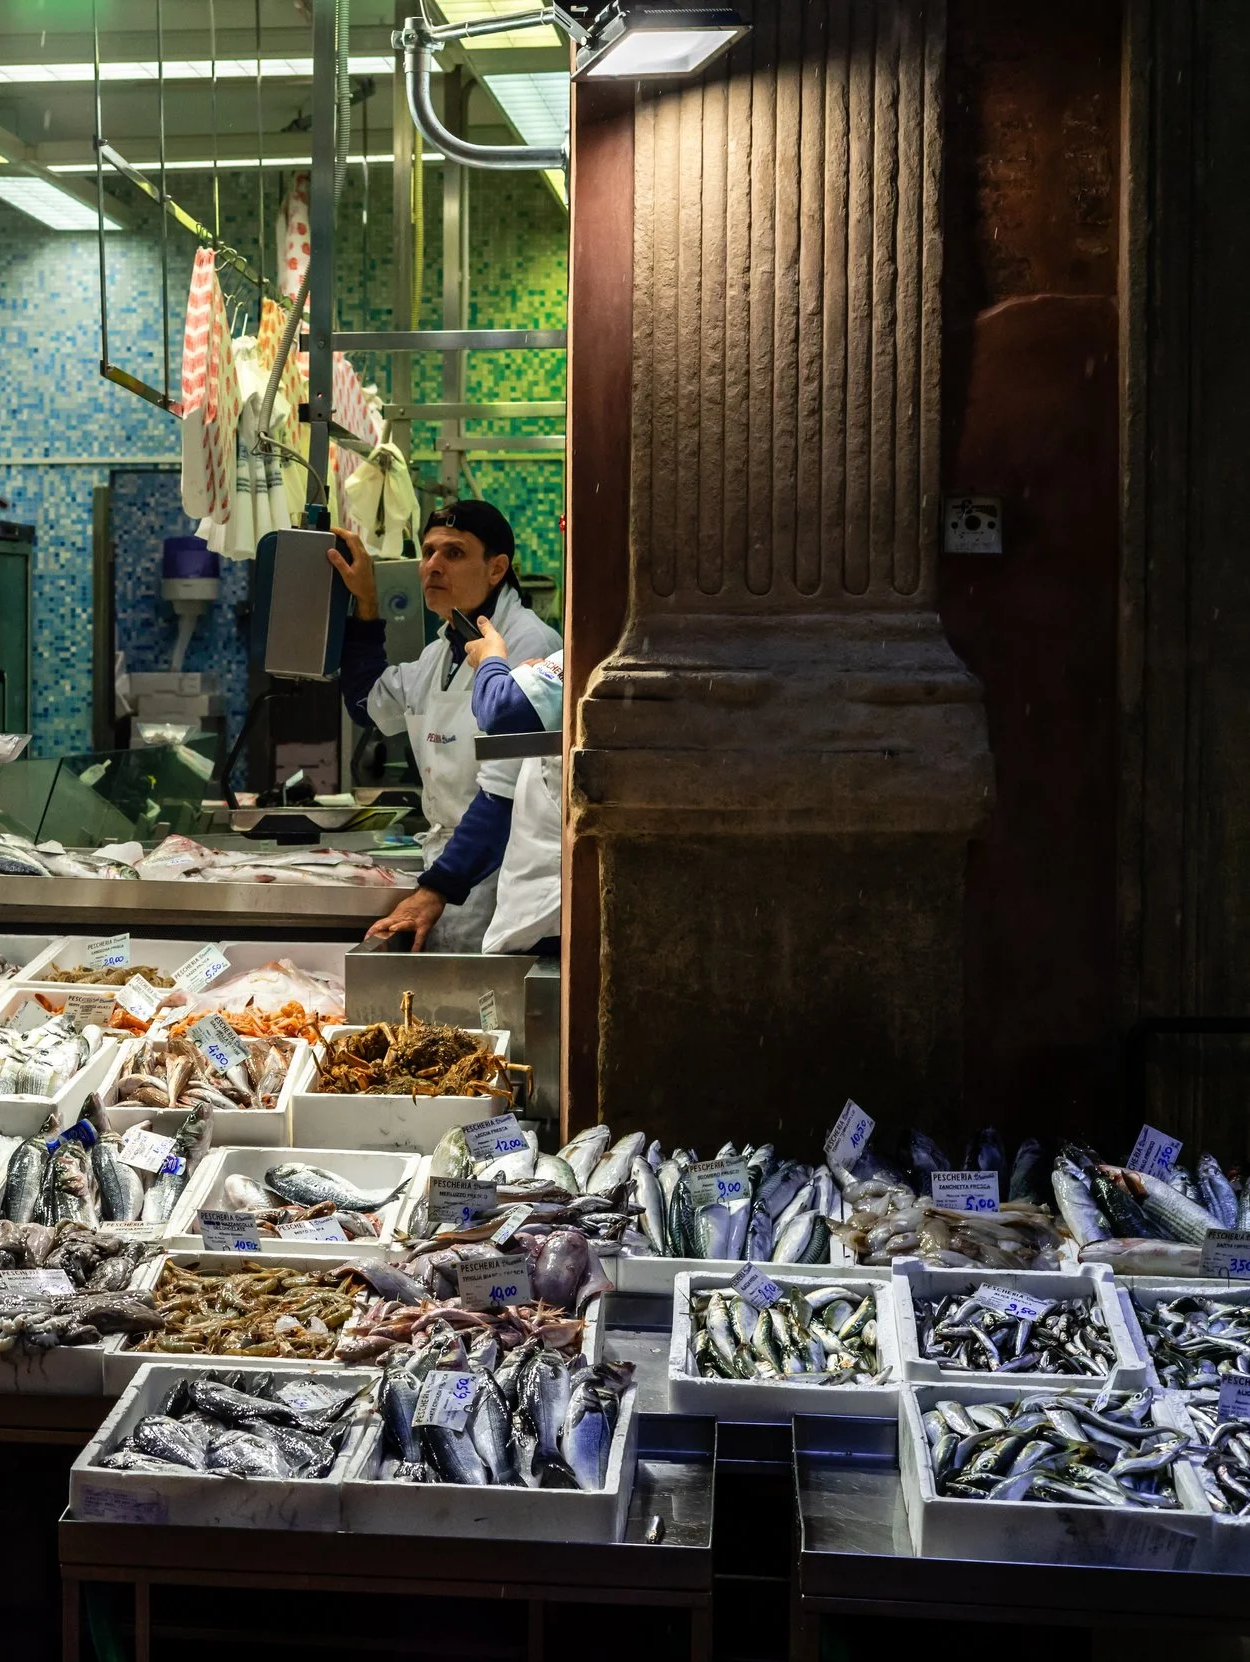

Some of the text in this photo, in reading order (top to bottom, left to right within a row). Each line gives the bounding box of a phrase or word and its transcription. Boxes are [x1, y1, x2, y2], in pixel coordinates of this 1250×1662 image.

[88, 938, 111, 949] PESCHERIA
[173, 957, 199, 978] PESCHERIA
[202, 961, 223, 979] 5,50
[206, 1043, 229, 1067] 4,50
[463, 1121, 495, 1133] PESCHERIA
[848, 1117, 869, 1150] 10,50
[825, 1119, 844, 1153] PESCHERIA
[495, 1138, 521, 1151] 12,00
[1143, 1140, 1155, 1159] FRESCO
[689, 1159, 725, 1173] PESCHERIA
[720, 1168, 739, 1176] FRESCO
[433, 1180, 471, 1189] PESCHERIA
[933, 1173, 972, 1182] PESCHERIA
[965, 1195, 996, 1212] 5,00
[200, 1212, 234, 1221] PESCHERIA
[1208, 1230, 1246, 1241] PESCHERIA
[460, 1259, 500, 1272] PESCHERIA
[487, 1281, 518, 1303] 10,00
[982, 1283, 1025, 1300] PESCHERIA
[1005, 1303, 1037, 1317] 9,50
[452, 1377, 472, 1400] 6,50
[416, 1390, 431, 1421] PESCHERIA
